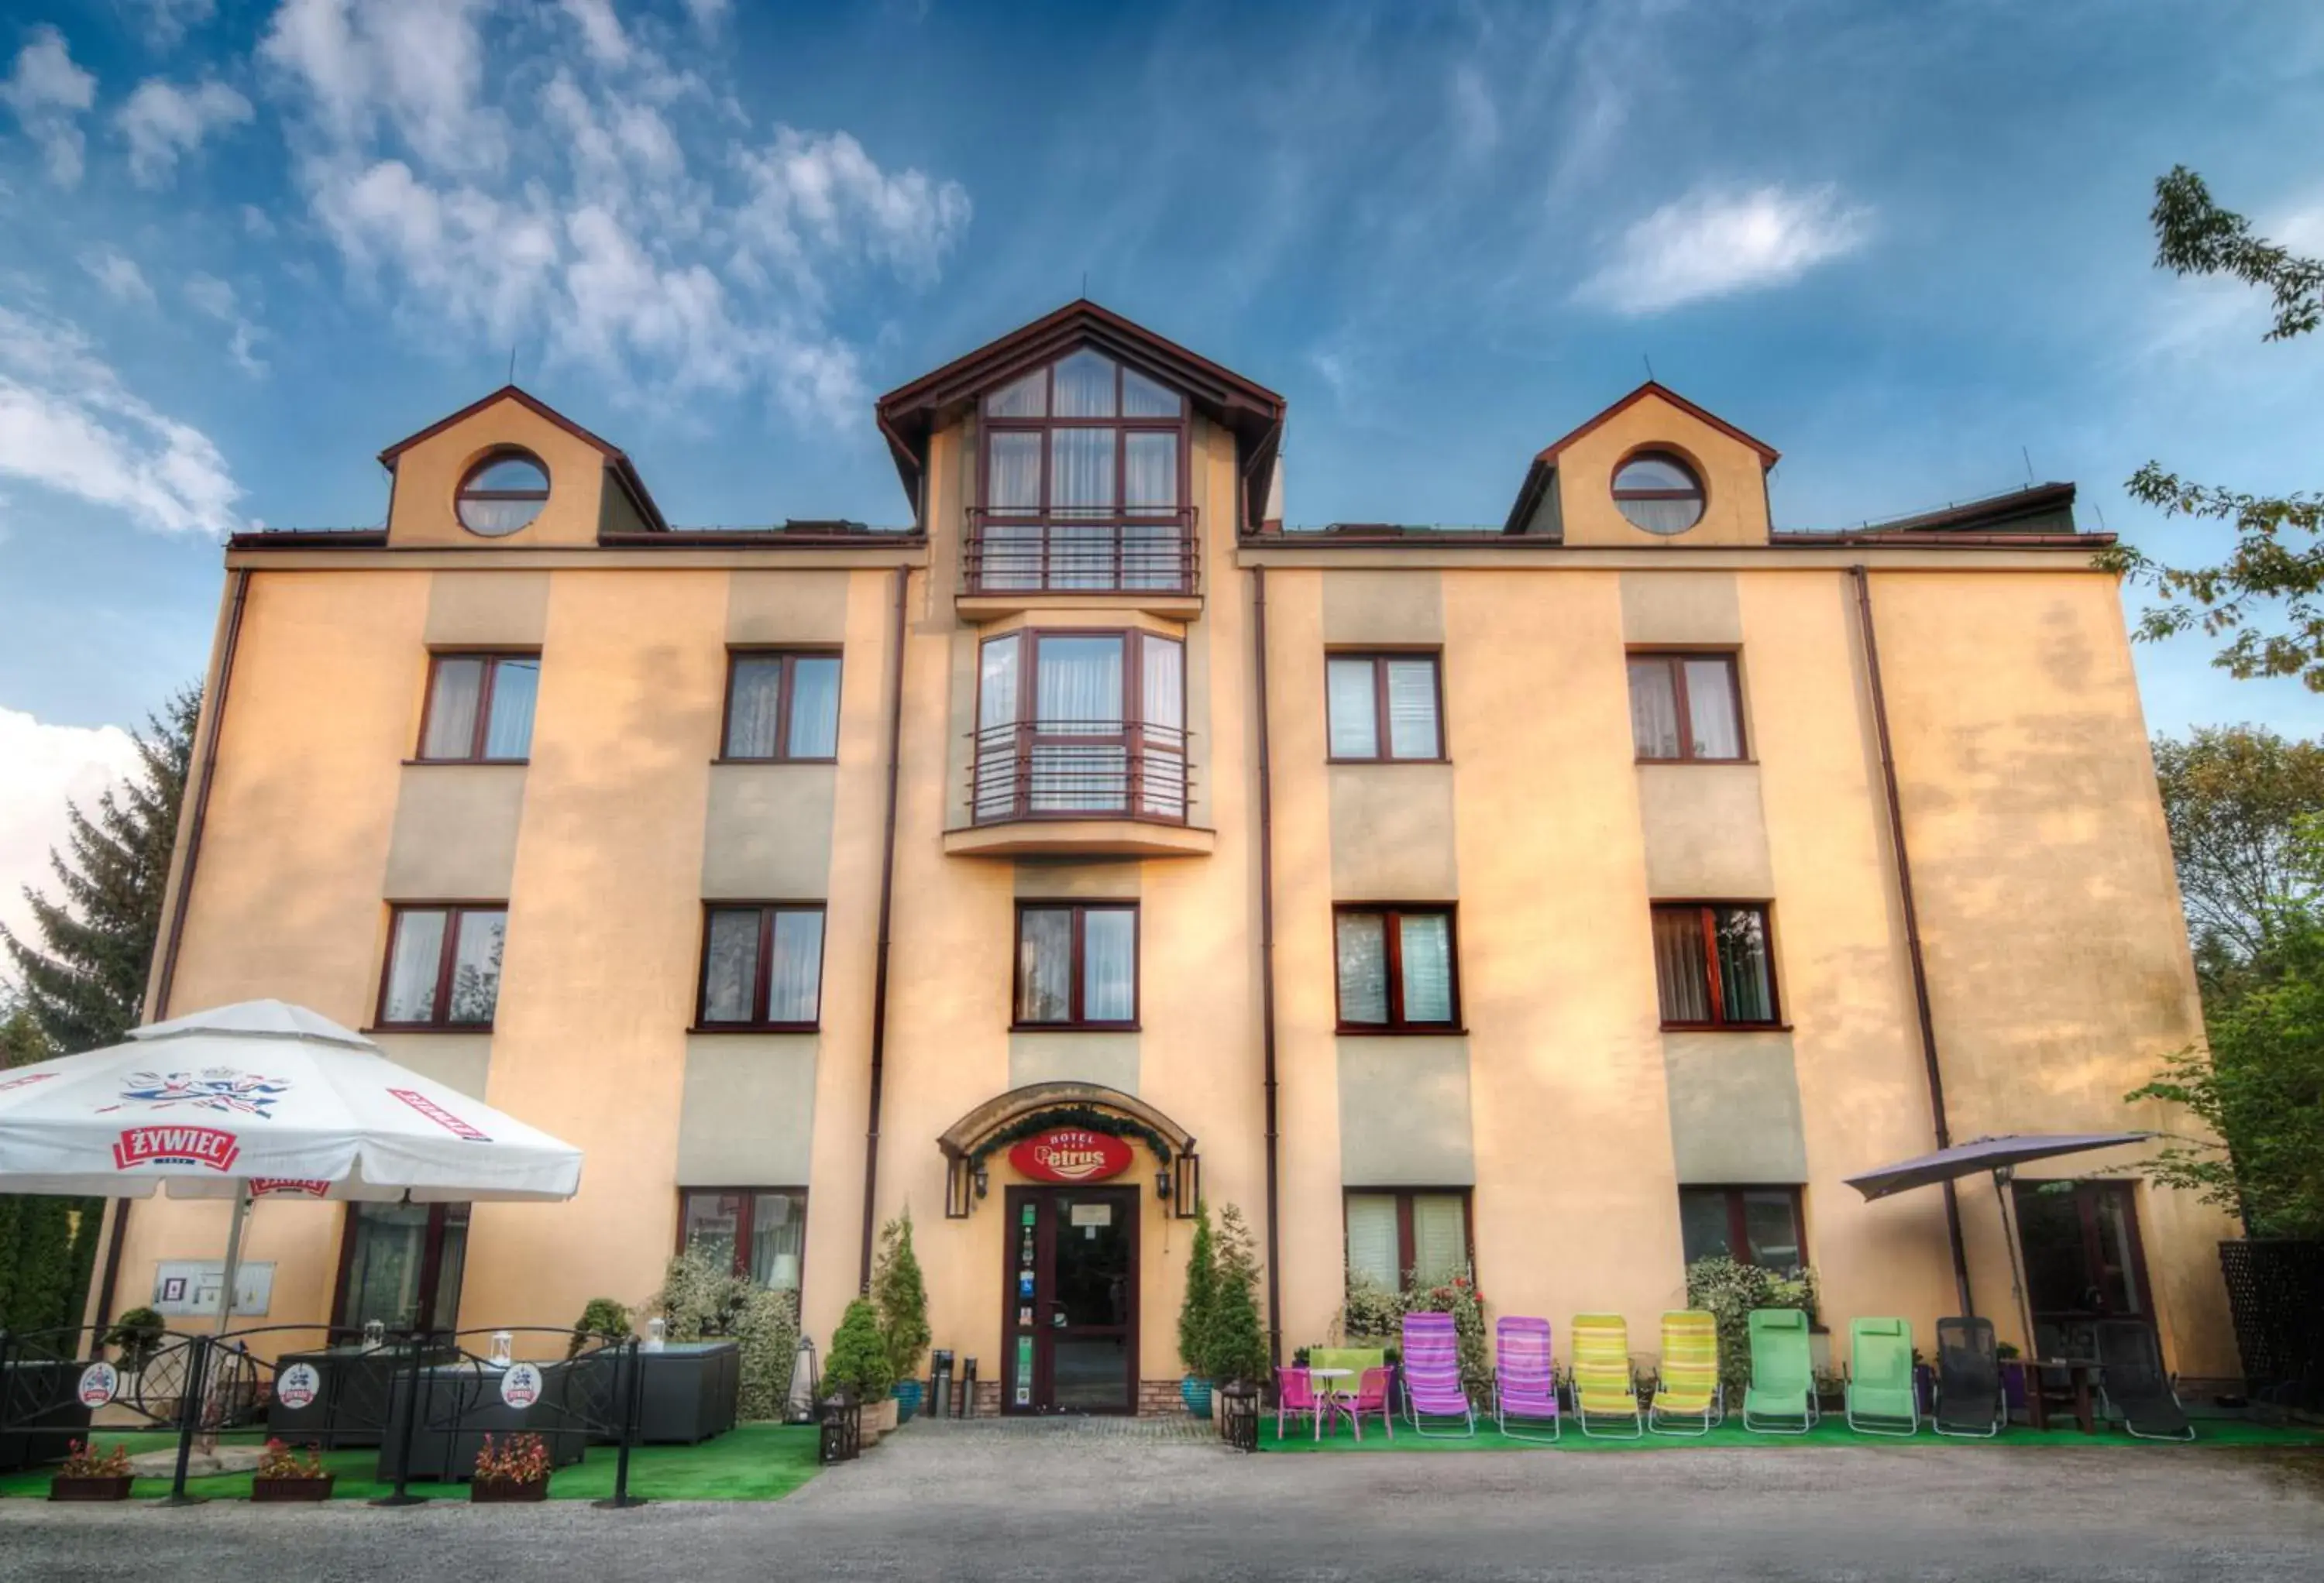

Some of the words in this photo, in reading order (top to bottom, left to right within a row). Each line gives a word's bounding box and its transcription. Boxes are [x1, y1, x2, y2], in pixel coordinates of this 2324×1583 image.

[131, 1128, 227, 1156] ŻYWIEC
[1050, 1132, 1095, 1145] HOTEL
[1034, 1145, 1105, 1166] Petrus
